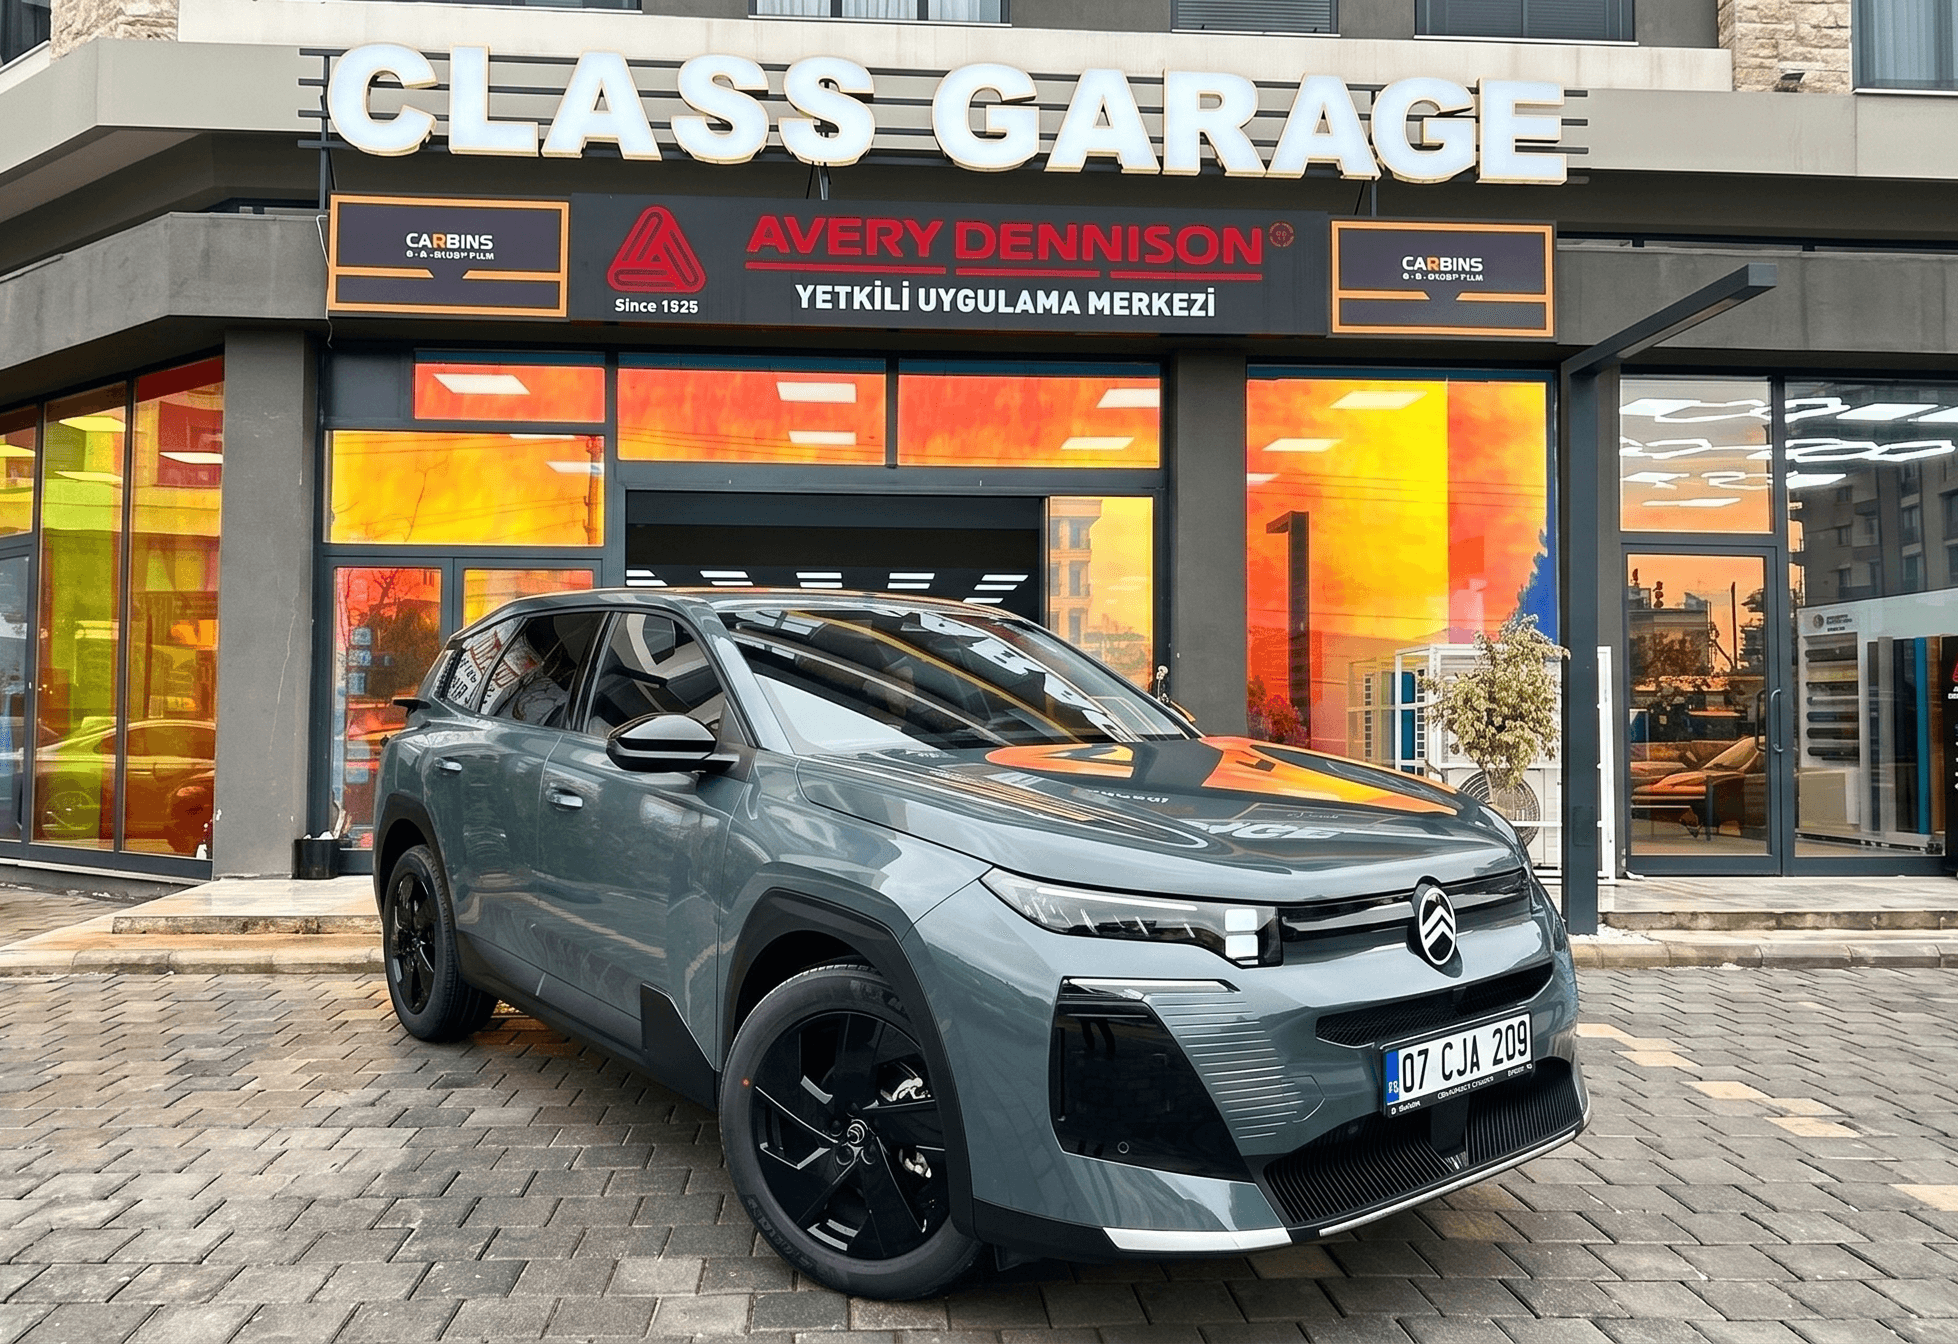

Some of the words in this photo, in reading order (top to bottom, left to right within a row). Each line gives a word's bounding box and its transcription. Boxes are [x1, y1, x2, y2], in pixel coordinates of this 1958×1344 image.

[327, 42, 876, 166] CLASS
[932, 62, 1568, 185] GARAGE
[405, 232, 494, 250] CARBINS
[746, 215, 944, 260] AVERY
[954, 220, 1264, 267] DENNISON
[1401, 255, 1484, 272] CARBINS
[614, 297, 657, 313] Since
[794, 279, 910, 311] YETKİLİ
[918, 287, 1081, 315] UYGULAMA
[1088, 287, 1215, 317] MERKEZİ
[1402, 1047, 1430, 1094] 07
[1441, 1034, 1481, 1082] CJA
[1492, 1019, 1528, 1067] 209
